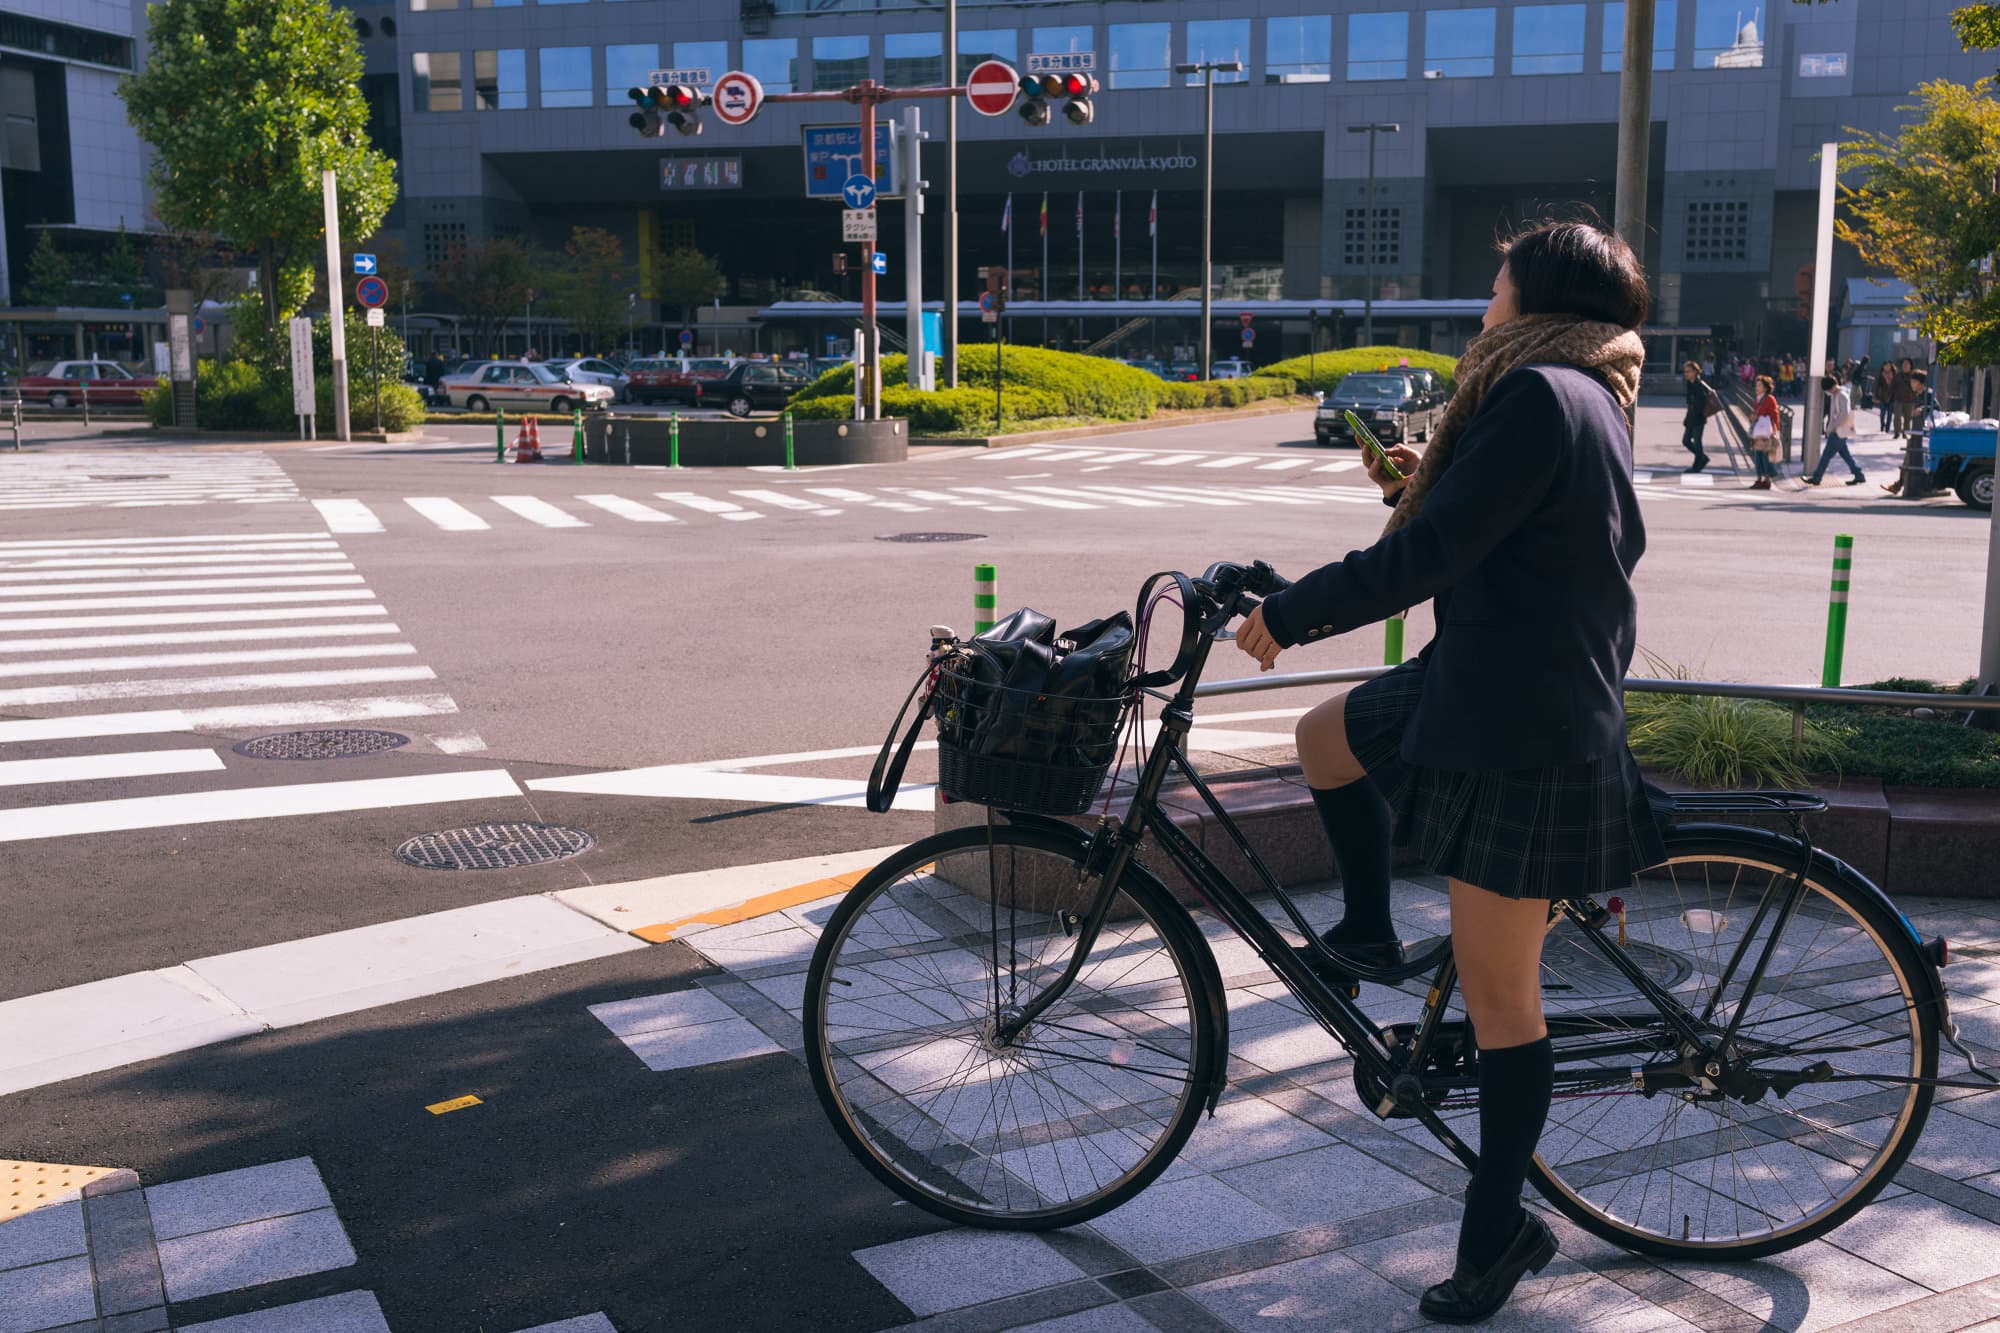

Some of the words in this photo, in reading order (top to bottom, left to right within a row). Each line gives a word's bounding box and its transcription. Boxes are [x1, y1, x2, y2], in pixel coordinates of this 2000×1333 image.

[1031, 55, 1092, 69] 歩車分離信号
[651, 70, 708, 85] 歩車分離信号
[1037, 159, 1076, 172] HOTEL
[1080, 157, 1146, 172] GRANVIA
[1150, 155, 1198, 171] KYOTO
[663, 160, 739, 187] 京都劇場
[845, 223, 875, 232] タクシー
